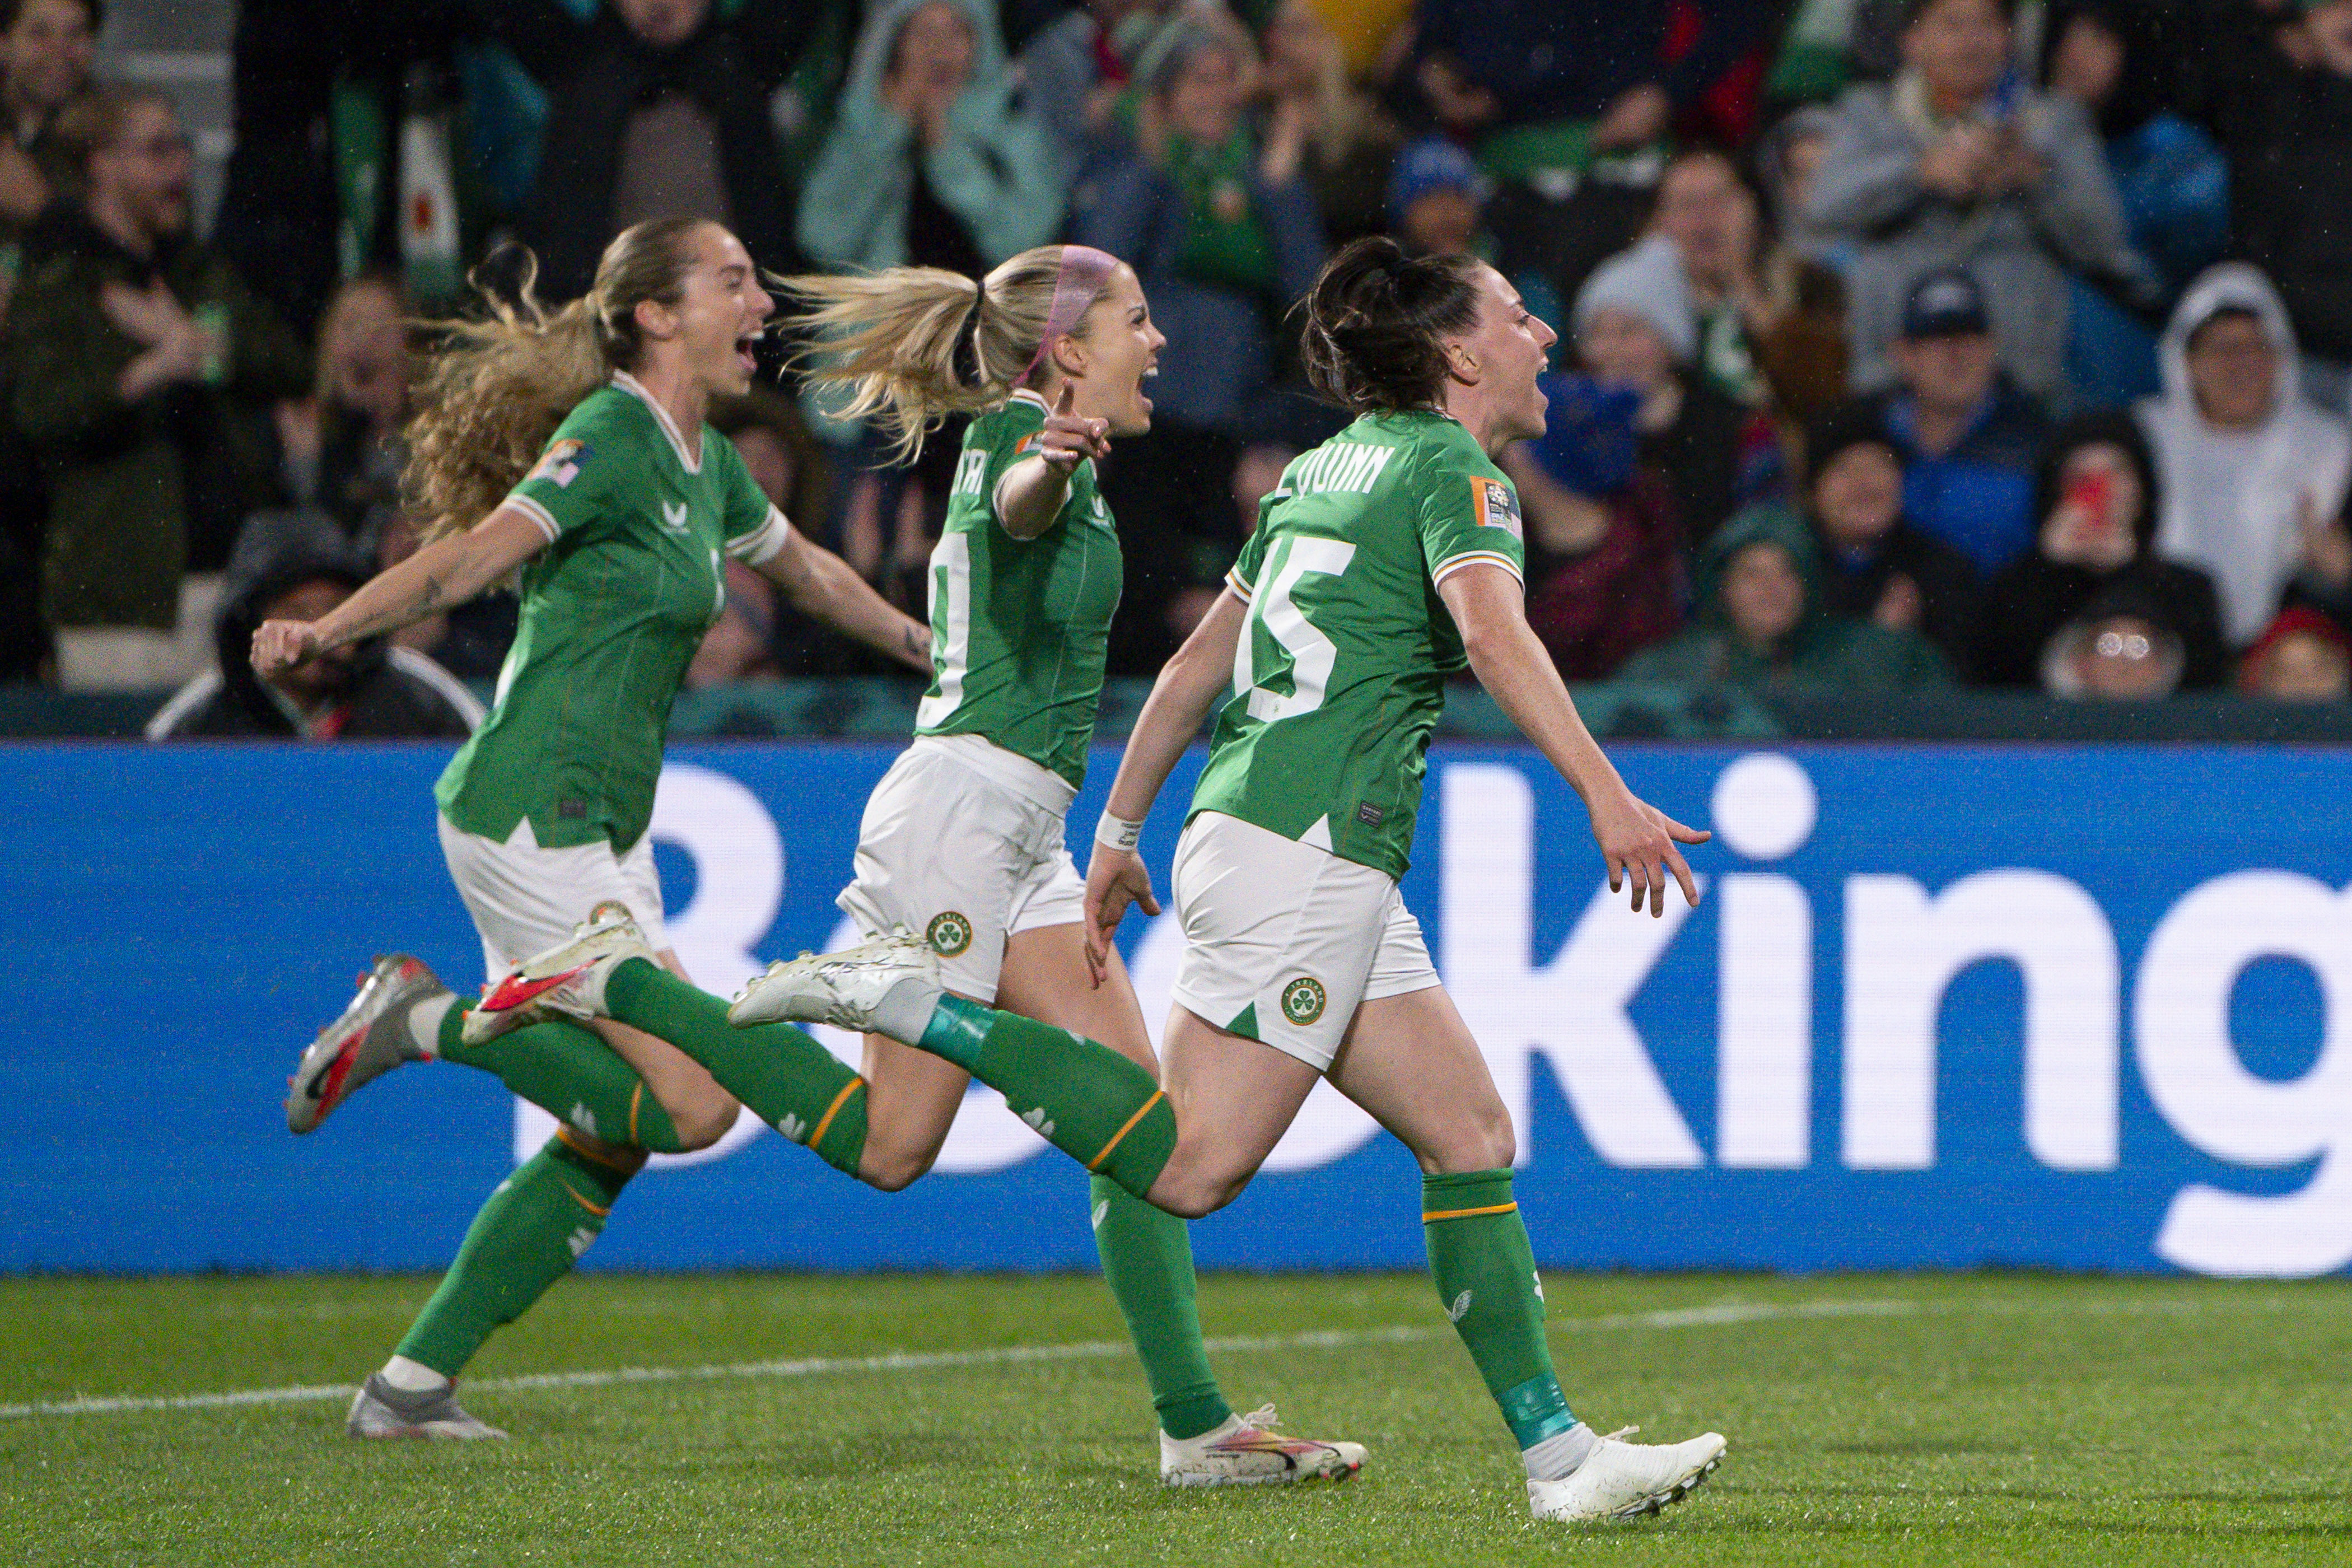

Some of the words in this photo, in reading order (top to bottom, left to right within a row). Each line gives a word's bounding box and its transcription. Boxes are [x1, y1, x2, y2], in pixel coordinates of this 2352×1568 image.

[1296, 442, 1396, 500] QUINN
[1234, 536, 1356, 723] 15
[514, 753, 2352, 1278] Bking
